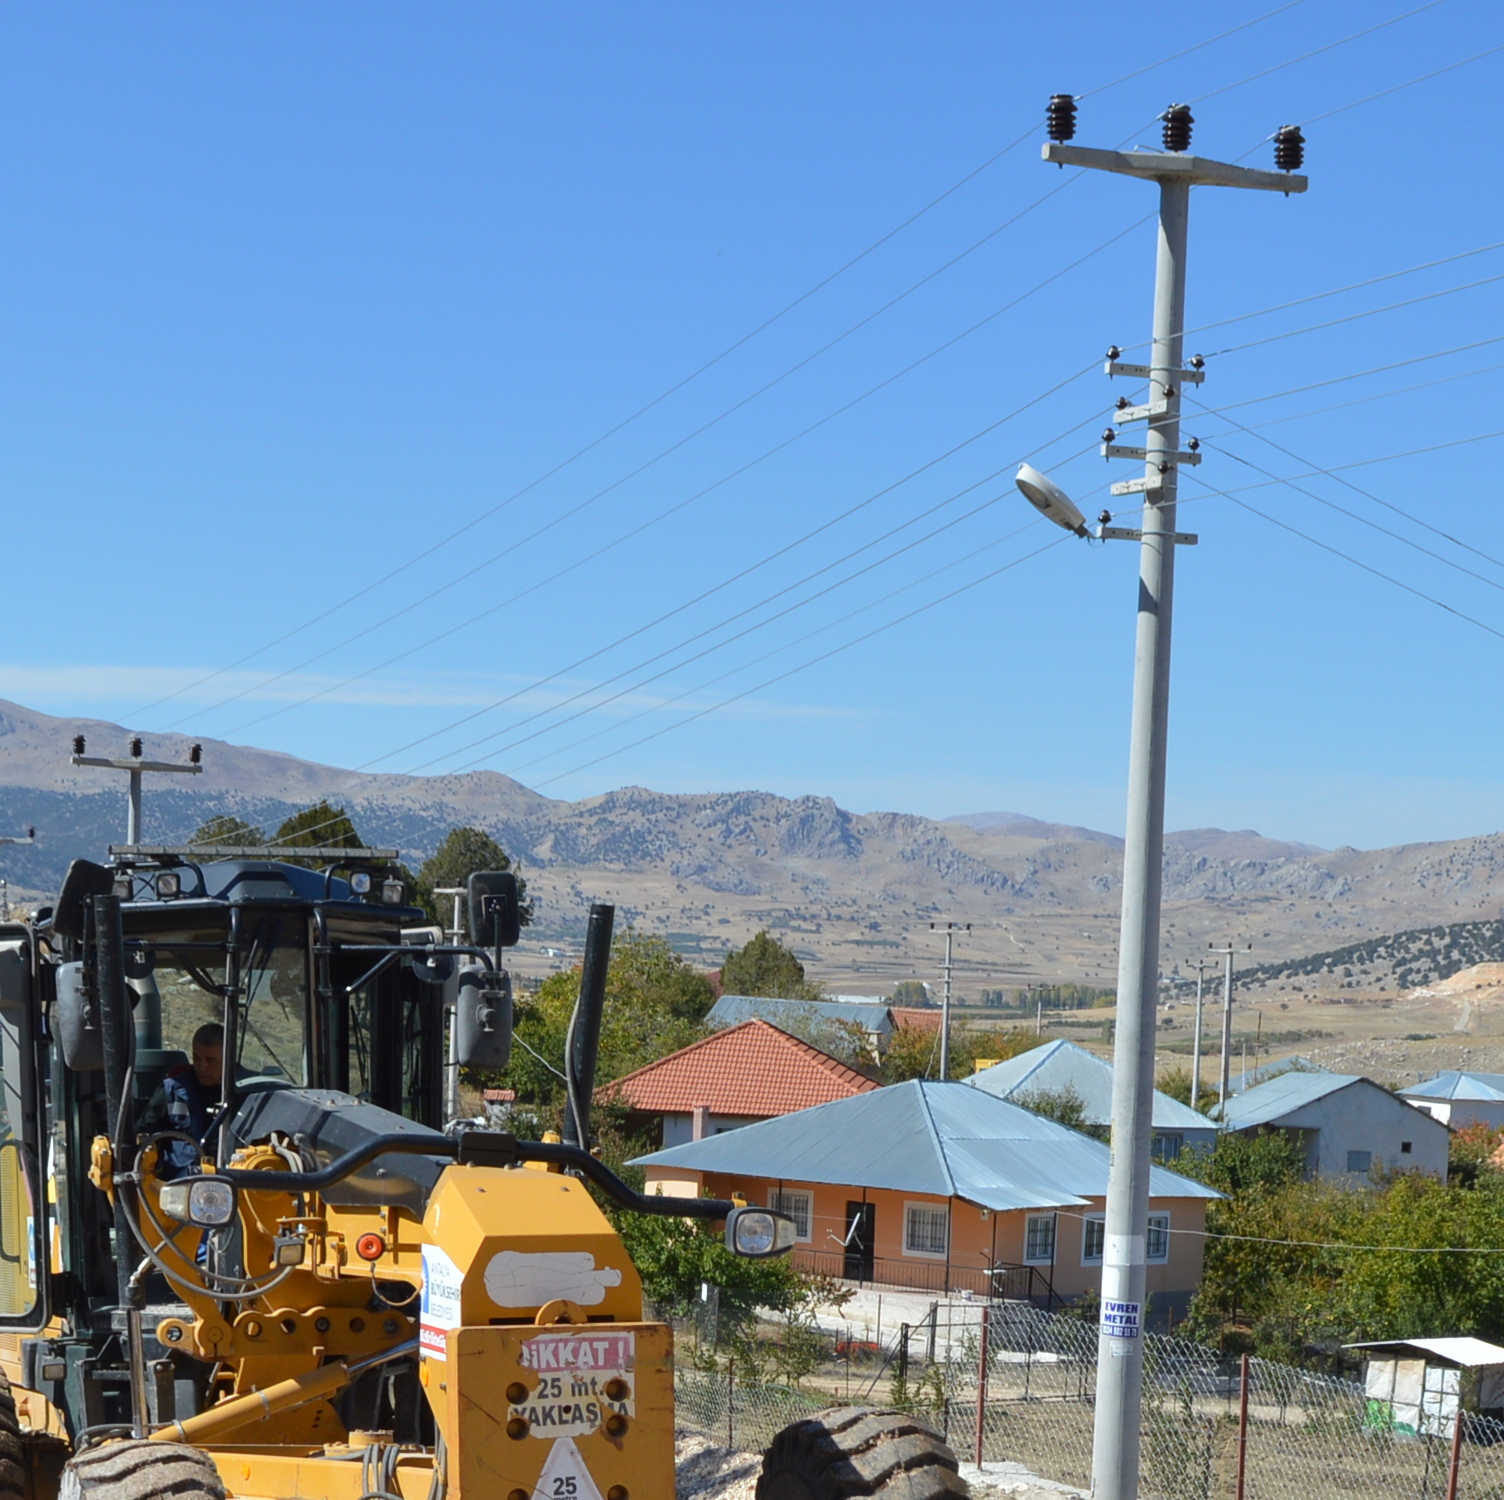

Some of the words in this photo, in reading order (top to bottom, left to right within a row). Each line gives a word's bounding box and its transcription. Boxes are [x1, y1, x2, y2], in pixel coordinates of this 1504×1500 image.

[1105, 1301, 1139, 1314] EVREN
[1104, 1312, 1138, 1326] METAL
[537, 1377, 562, 1400] 25
[552, 1476, 578, 1496] 25
